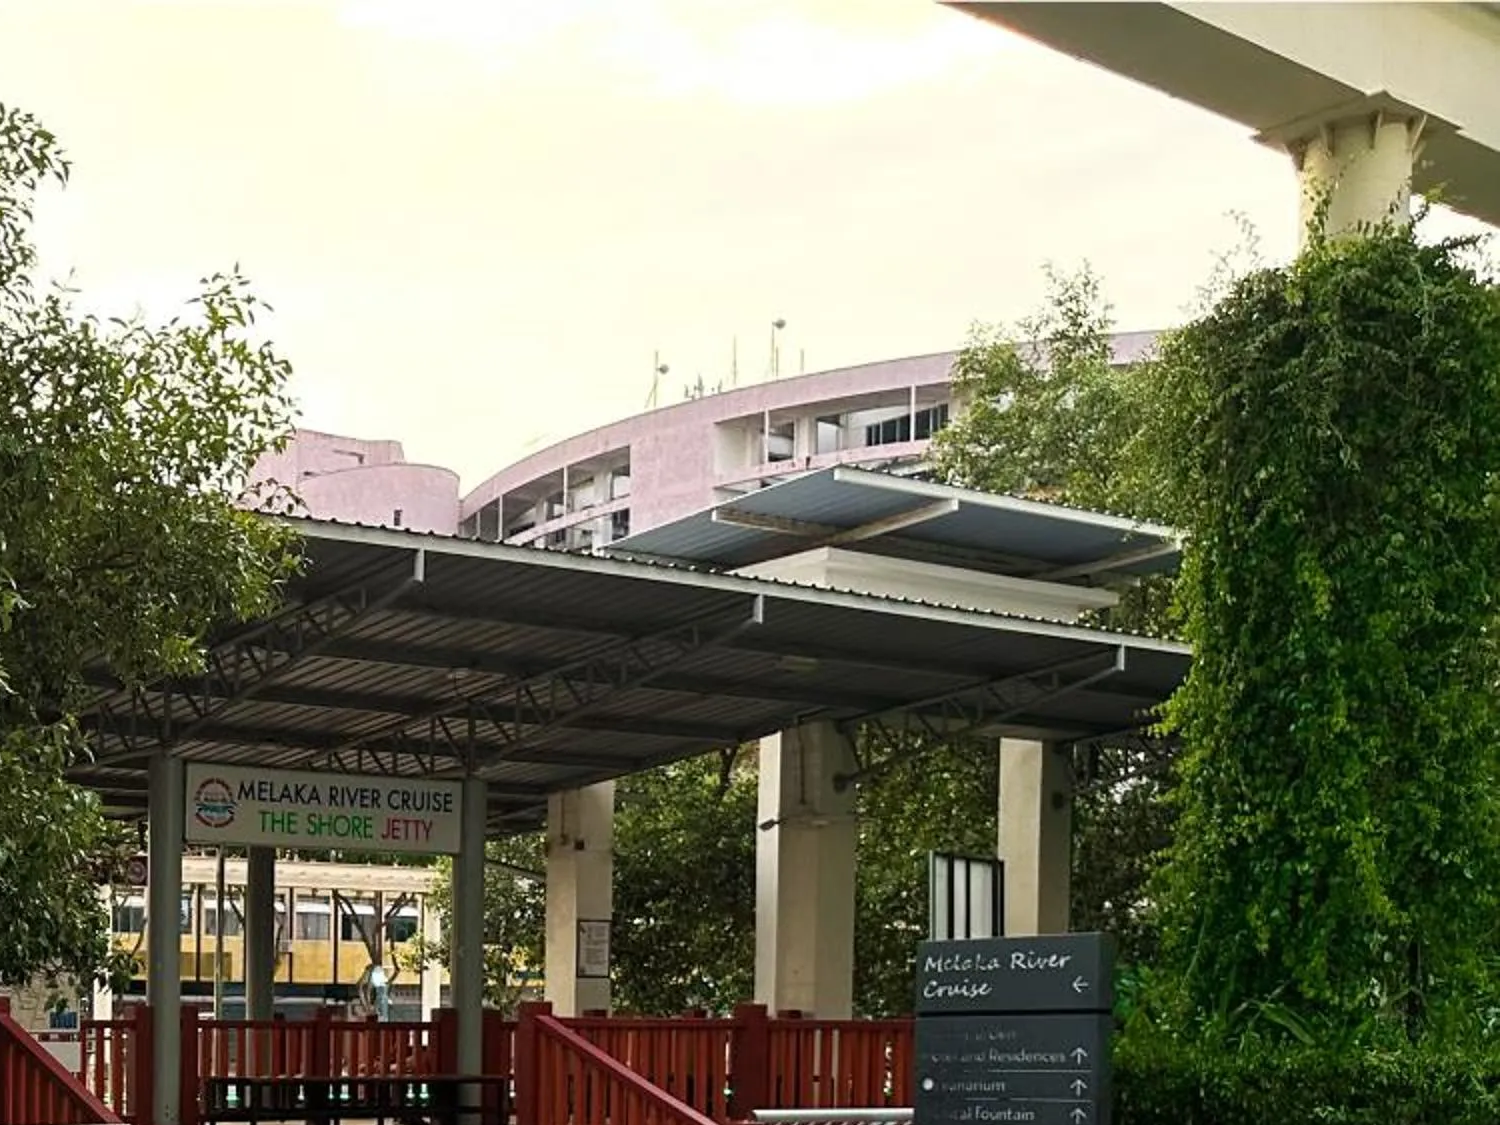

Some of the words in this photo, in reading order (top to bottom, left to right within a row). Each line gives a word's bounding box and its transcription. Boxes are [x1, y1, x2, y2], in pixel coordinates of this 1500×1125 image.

[237, 780, 321, 805] MELAKA
[328, 785, 381, 809] RIVER
[387, 789, 453, 813] CRUISE
[258, 811, 297, 834] THE
[306, 812, 373, 839] SHORE
[381, 818, 433, 841] JETTY
[1010, 949, 1072, 969] River
[923, 978, 993, 998] Cruise
